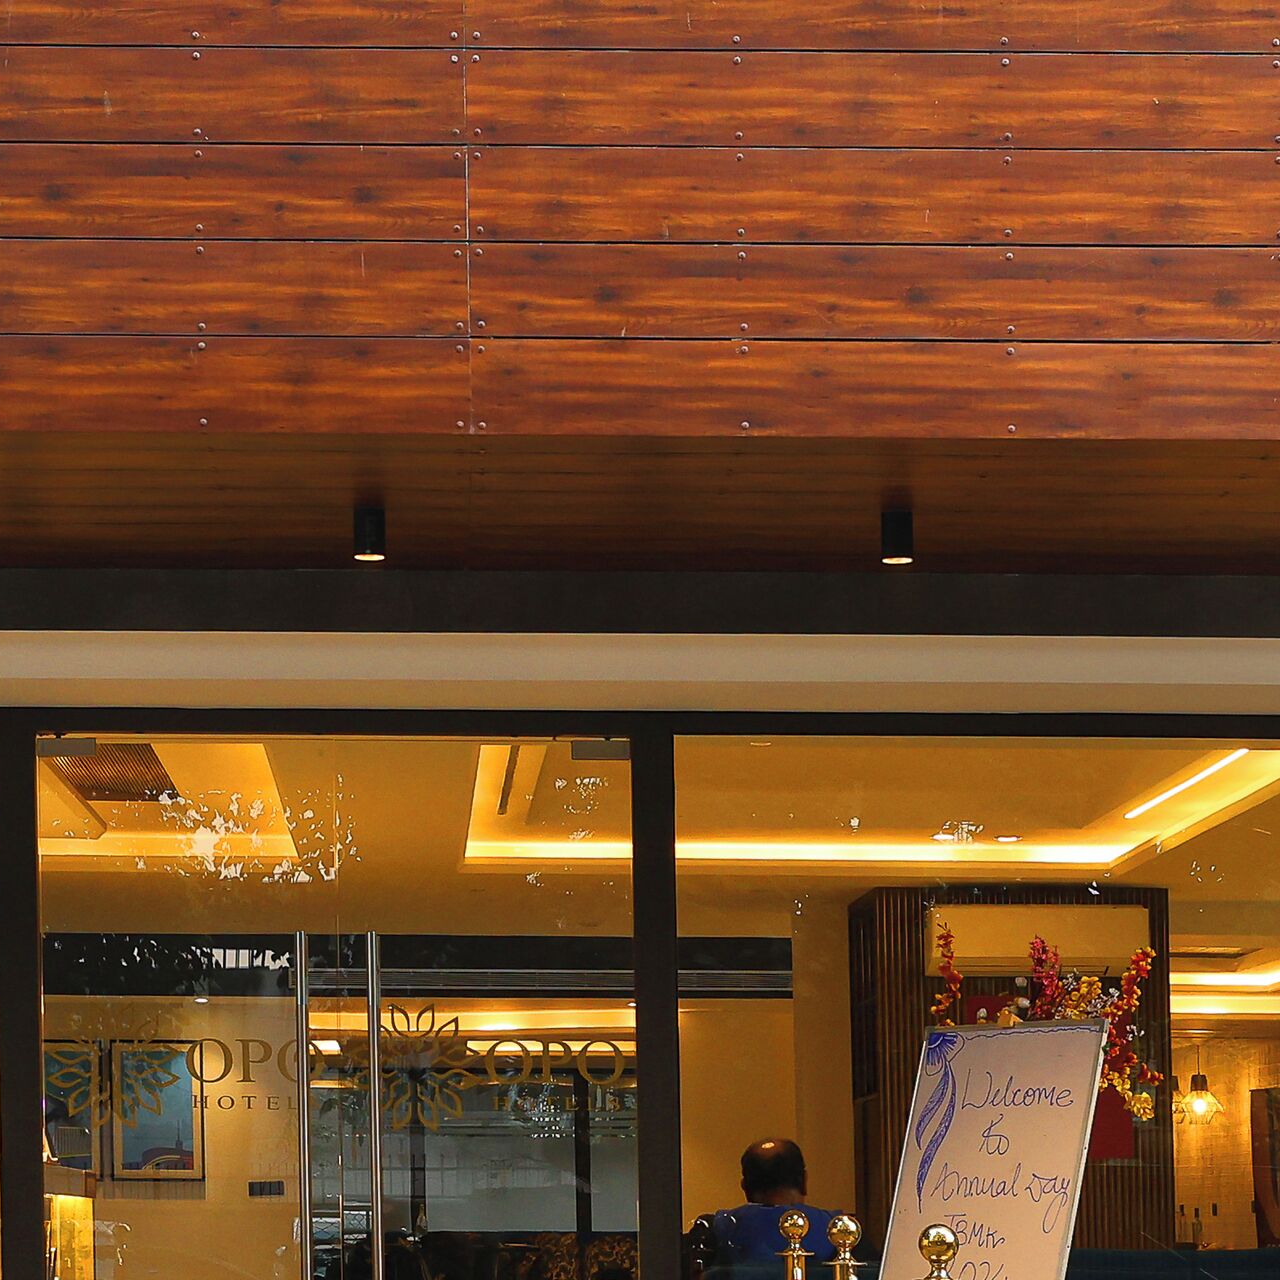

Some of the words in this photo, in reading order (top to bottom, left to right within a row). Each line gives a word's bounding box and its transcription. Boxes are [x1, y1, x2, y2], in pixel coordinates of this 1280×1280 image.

[185, 1037, 324, 1084] OPO
[484, 1039, 626, 1086] OPO
[192, 1095, 320, 1111] HOTEL
[961, 1068, 1074, 1110] Welcome
[930, 1162, 1022, 1202] Annual
[1024, 1172, 1071, 1234] Day
